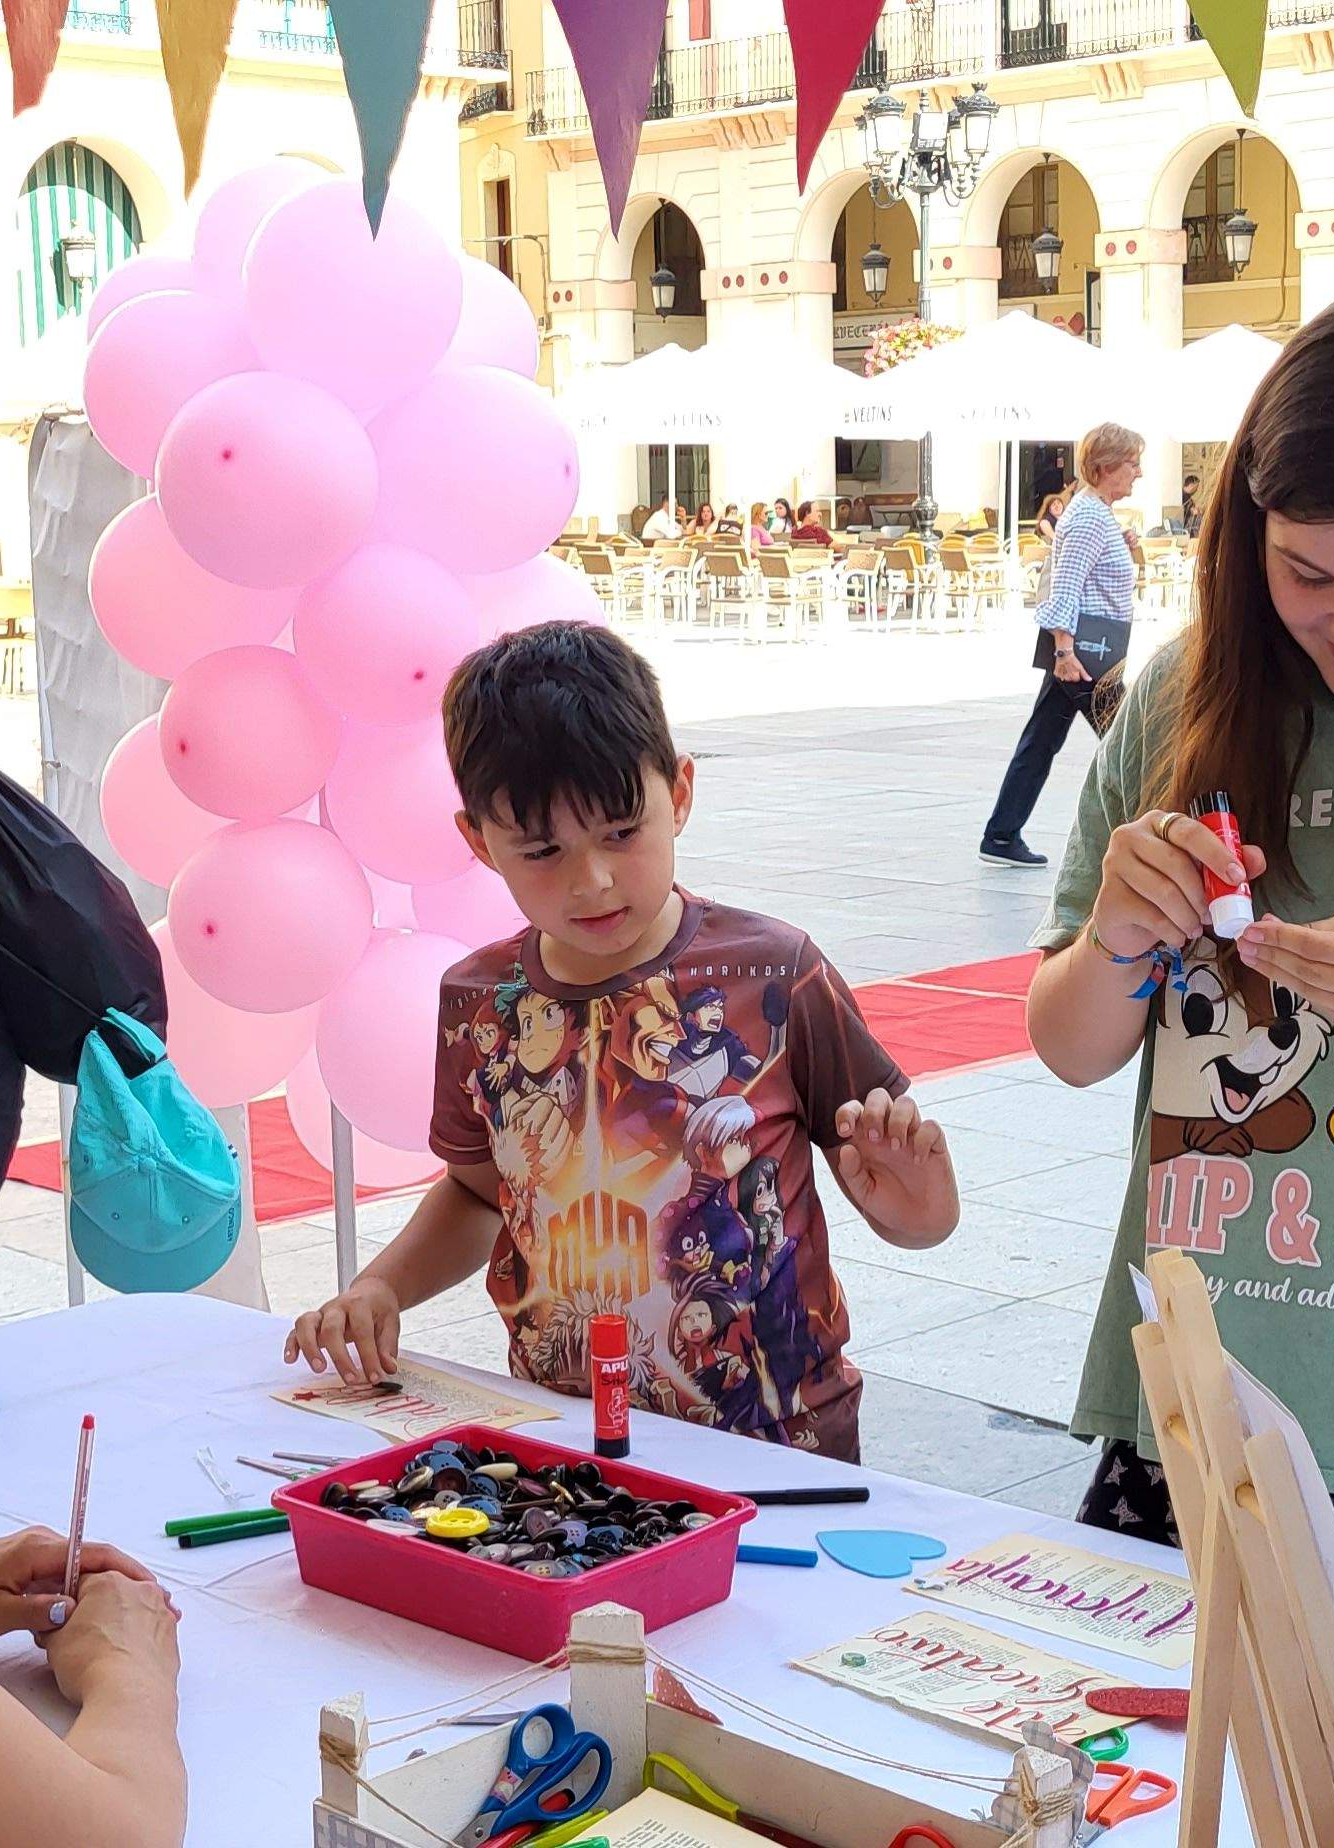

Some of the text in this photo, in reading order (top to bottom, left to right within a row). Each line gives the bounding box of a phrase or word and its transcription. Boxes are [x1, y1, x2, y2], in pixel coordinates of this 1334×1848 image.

[853, 406, 892, 423] VELTINS
[1266, 1168, 1322, 1269] &
[1233, 1276, 1293, 1304] and
